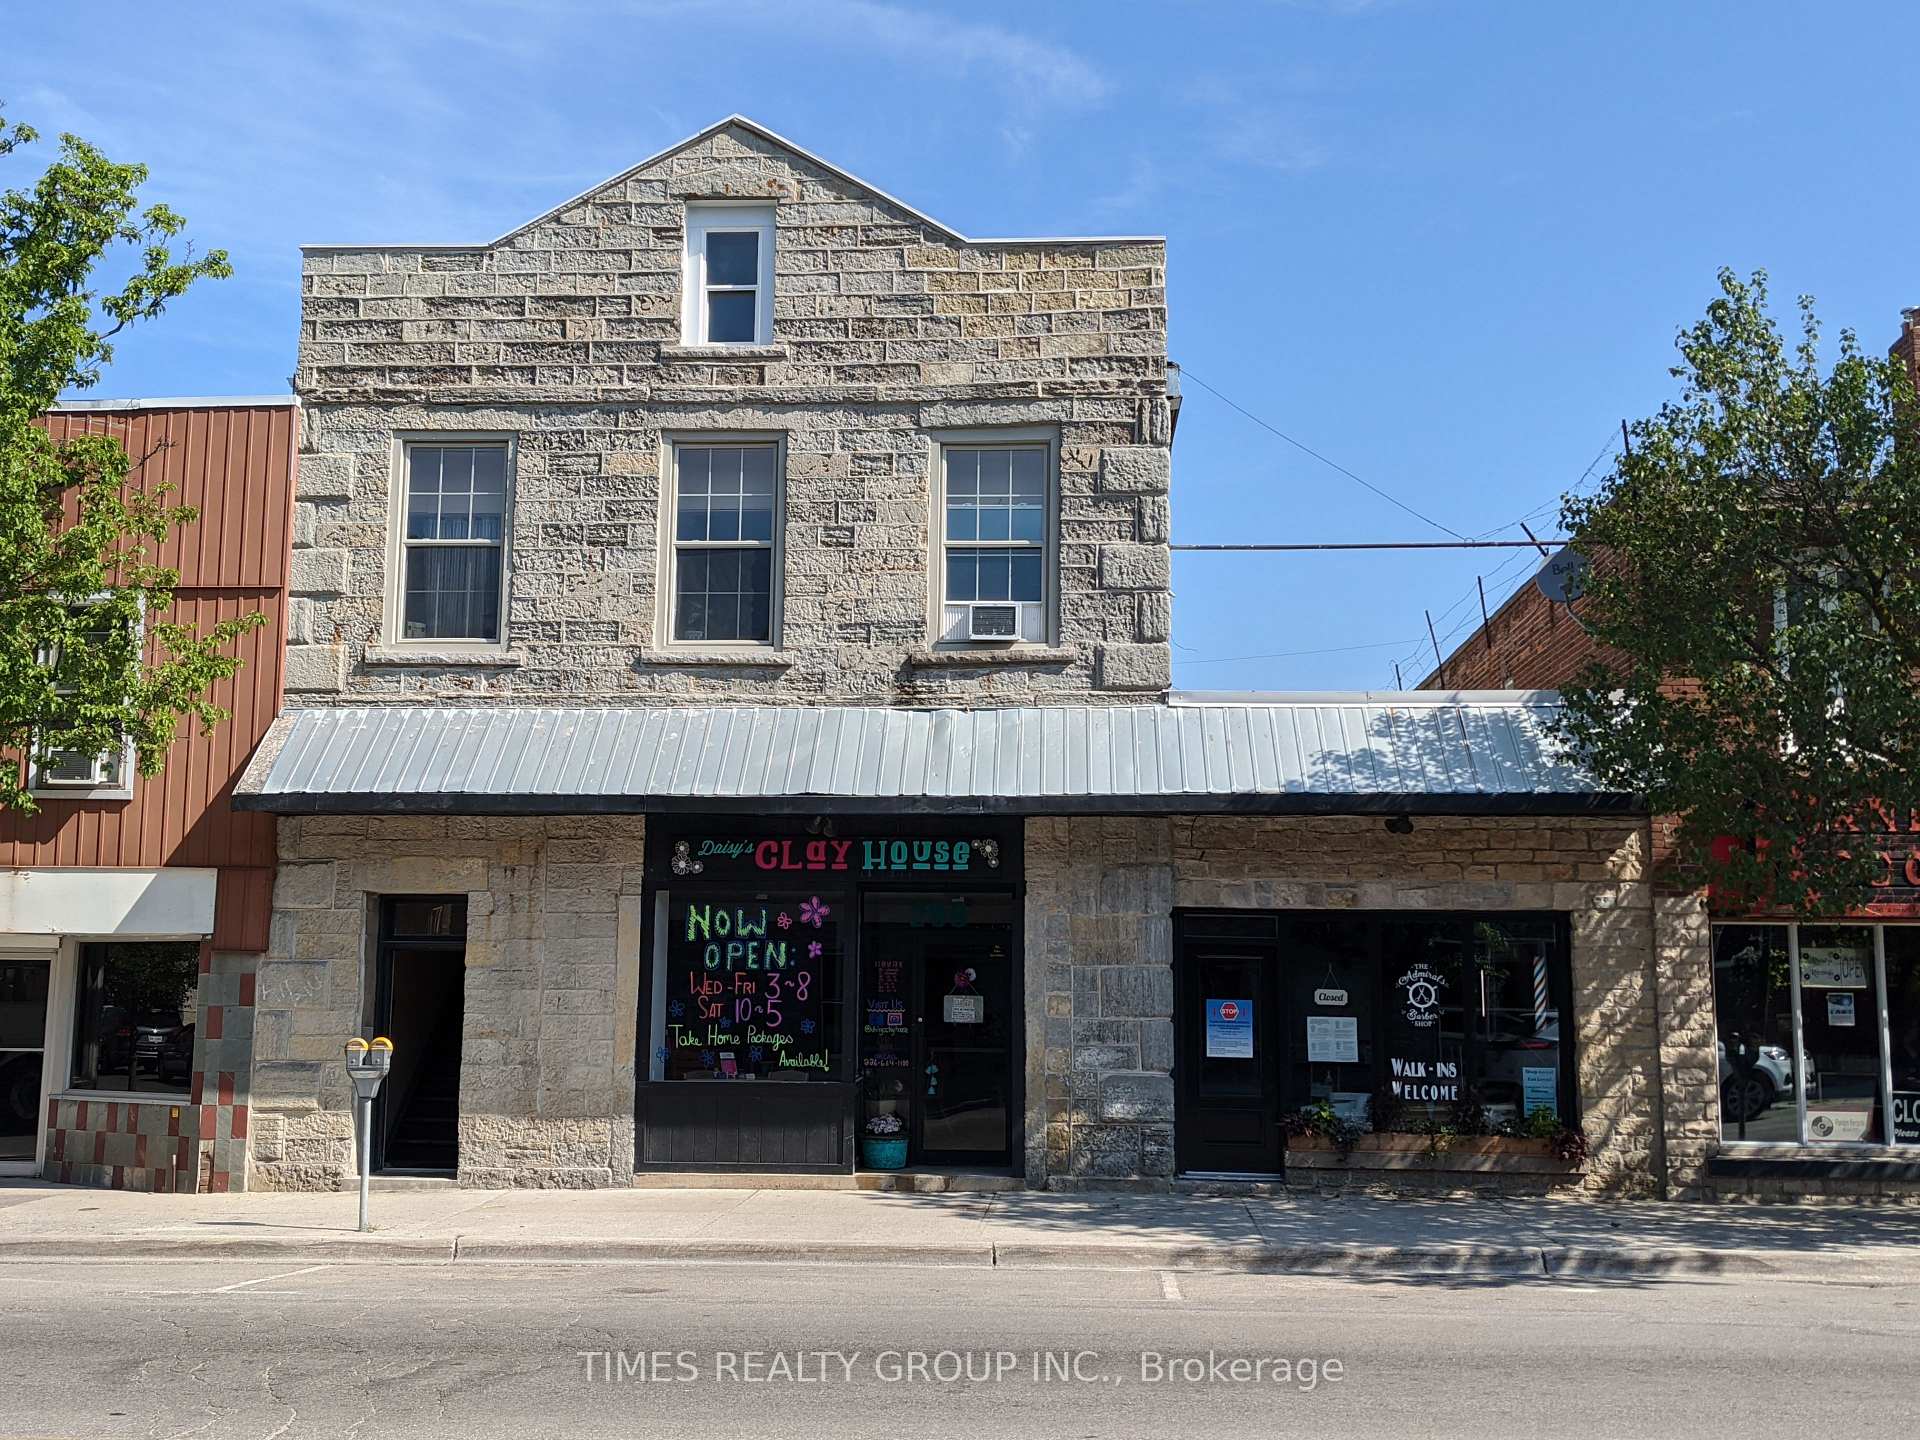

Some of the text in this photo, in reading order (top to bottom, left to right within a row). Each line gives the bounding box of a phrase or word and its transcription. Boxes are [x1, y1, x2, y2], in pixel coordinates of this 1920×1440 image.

[698, 840, 756, 859] Daisy's
[686, 904, 768, 942] NOW
[1319, 992, 1344, 1002] Closed
[1221, 1007, 1239, 1015] STOP
[1406, 1008, 1438, 1021] Barber
[1414, 1020, 1433, 1028] SHOP
[668, 1024, 794, 1052] Take Home Packages
[778, 1049, 832, 1072] Available!
[1391, 1080, 1458, 1101] WELCOME
